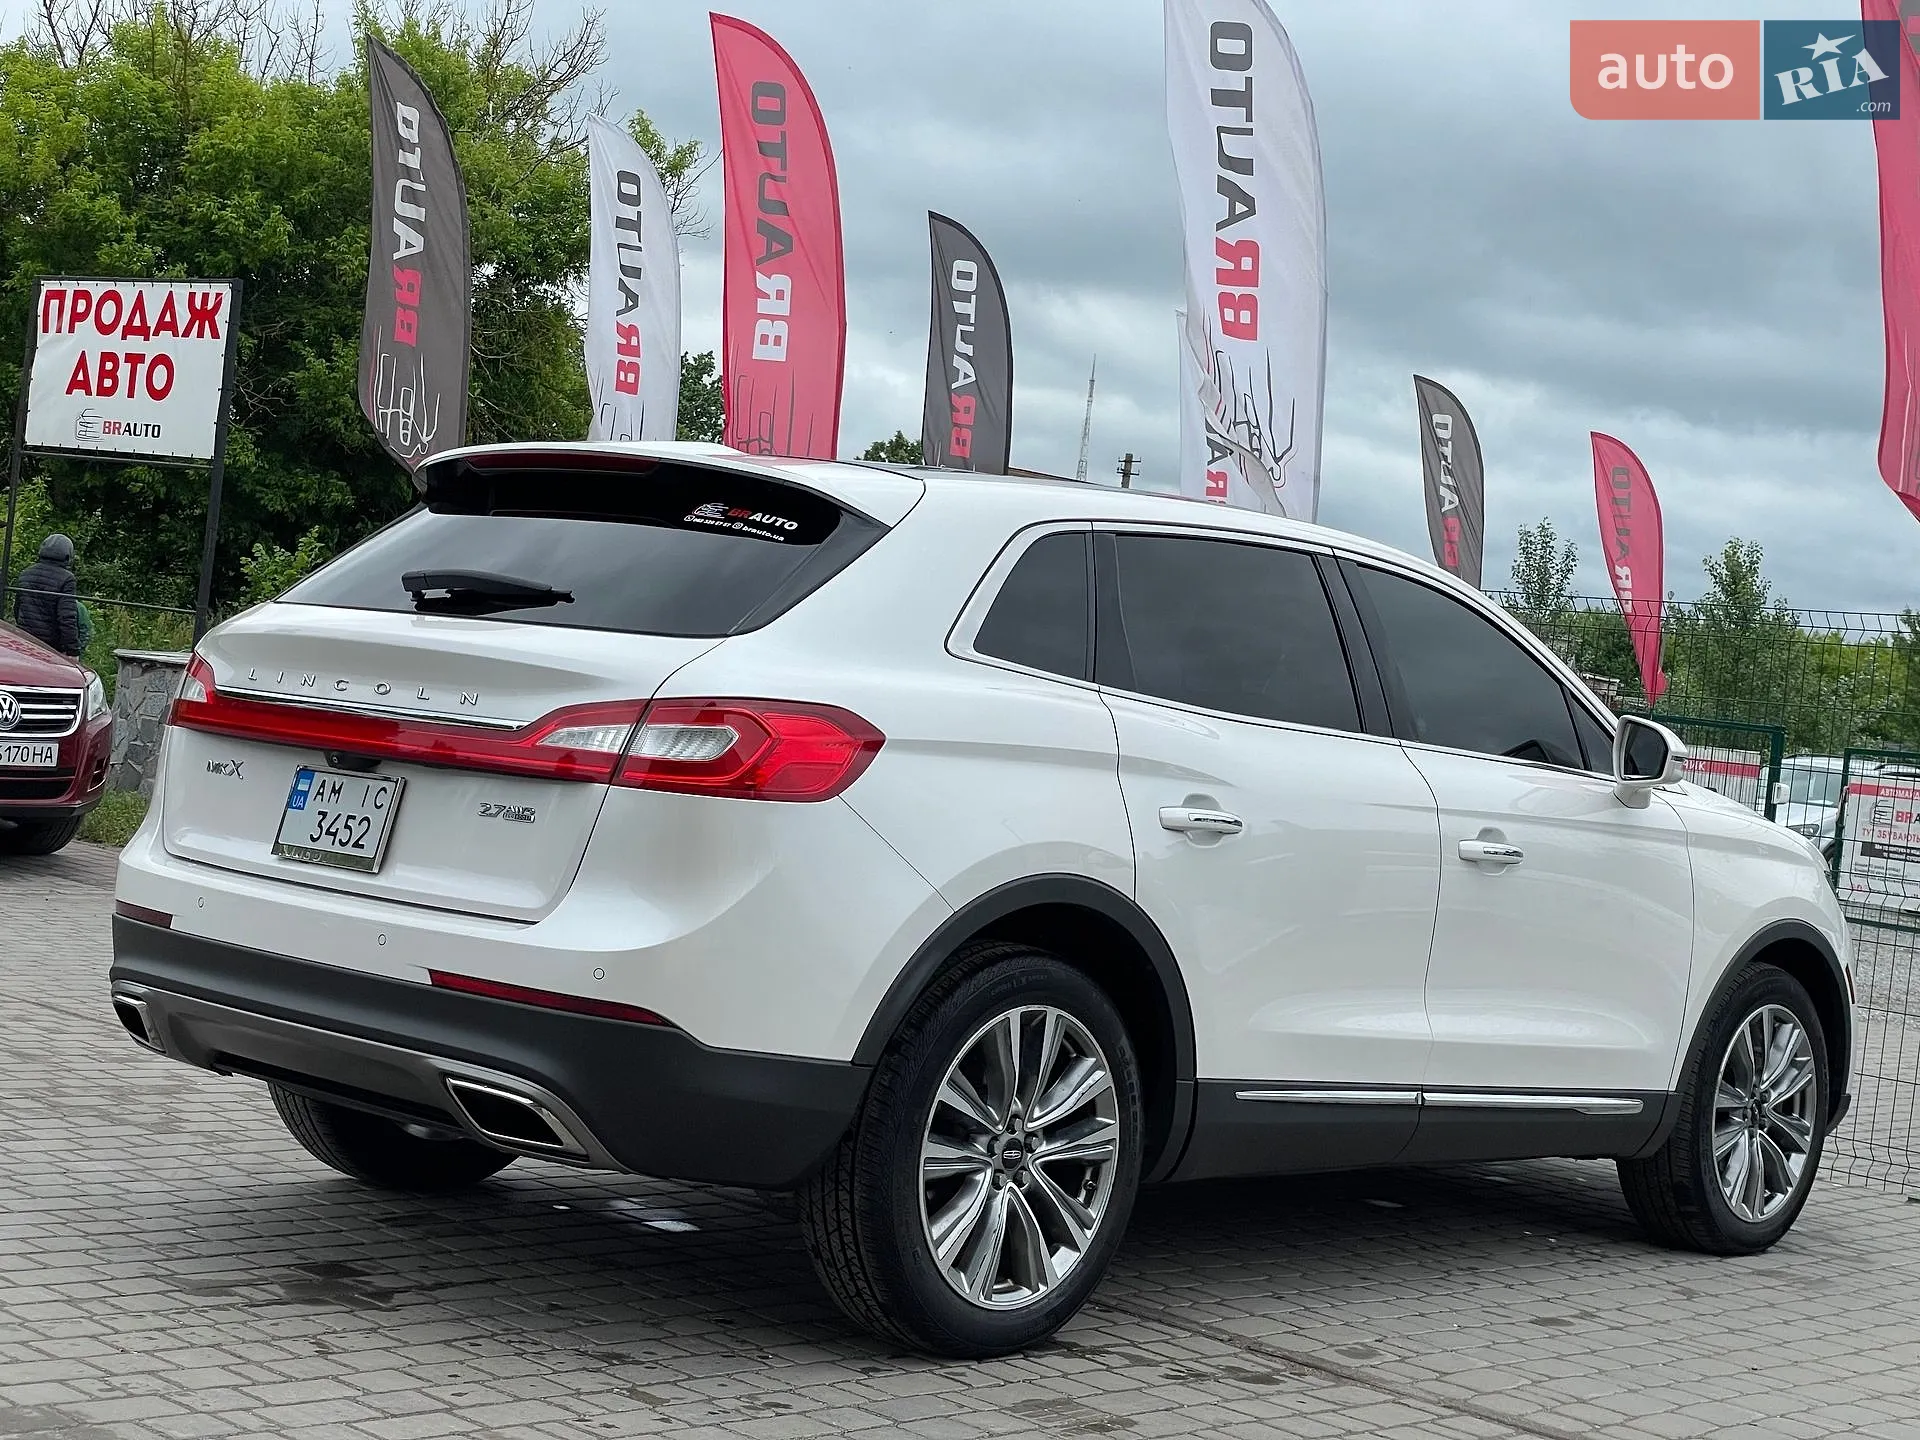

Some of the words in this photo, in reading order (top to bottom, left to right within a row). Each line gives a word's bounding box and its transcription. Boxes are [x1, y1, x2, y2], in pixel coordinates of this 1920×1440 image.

[41, 289, 223, 341] ПРОДАЖ
[65, 350, 175, 401] АВТО
[102, 420, 161, 438] BRAUTO
[727, 508, 798, 531] BRAUTO
[742, 525, 785, 541] brauto.ua
[248, 667, 479, 705] LINCOLN
[292, 795, 305, 809] UA
[313, 779, 344, 805] AM
[309, 810, 372, 849] 3452
